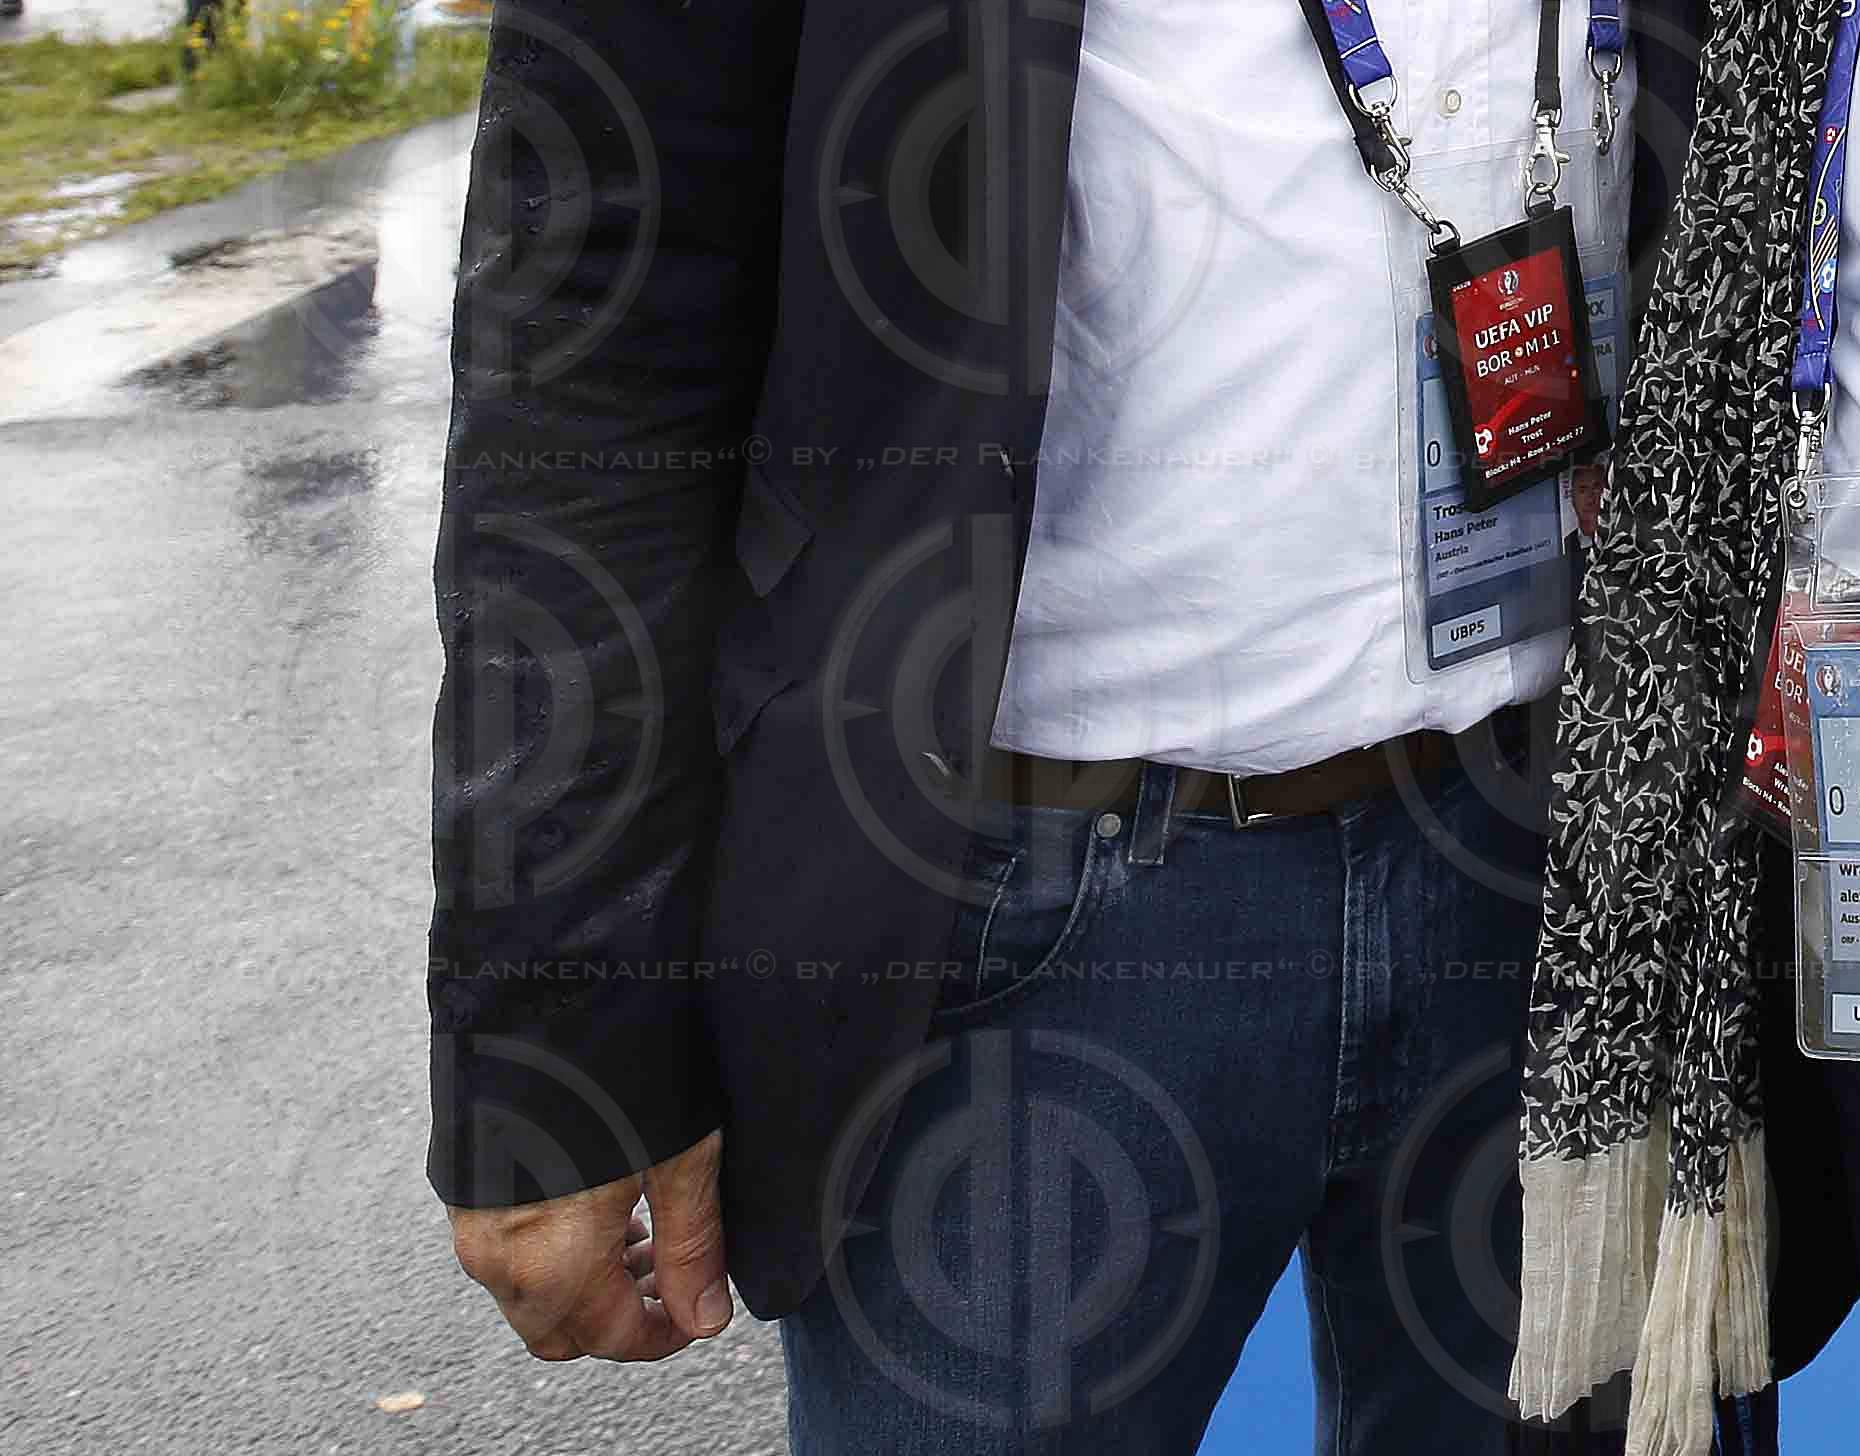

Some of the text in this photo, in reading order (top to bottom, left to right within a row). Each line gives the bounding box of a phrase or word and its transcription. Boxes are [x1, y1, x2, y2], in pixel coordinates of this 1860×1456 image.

[1474, 320, 1521, 350] UEFA
[1524, 303, 1555, 332] VIP
[1476, 349, 1514, 379] BOR
[1521, 428, 1544, 444] Trost
[1433, 501, 1464, 521] Tros
[1434, 516, 1498, 544] Hans Peter
[1435, 545, 1469, 562] Austria
[1449, 620, 1485, 642] UBP5
